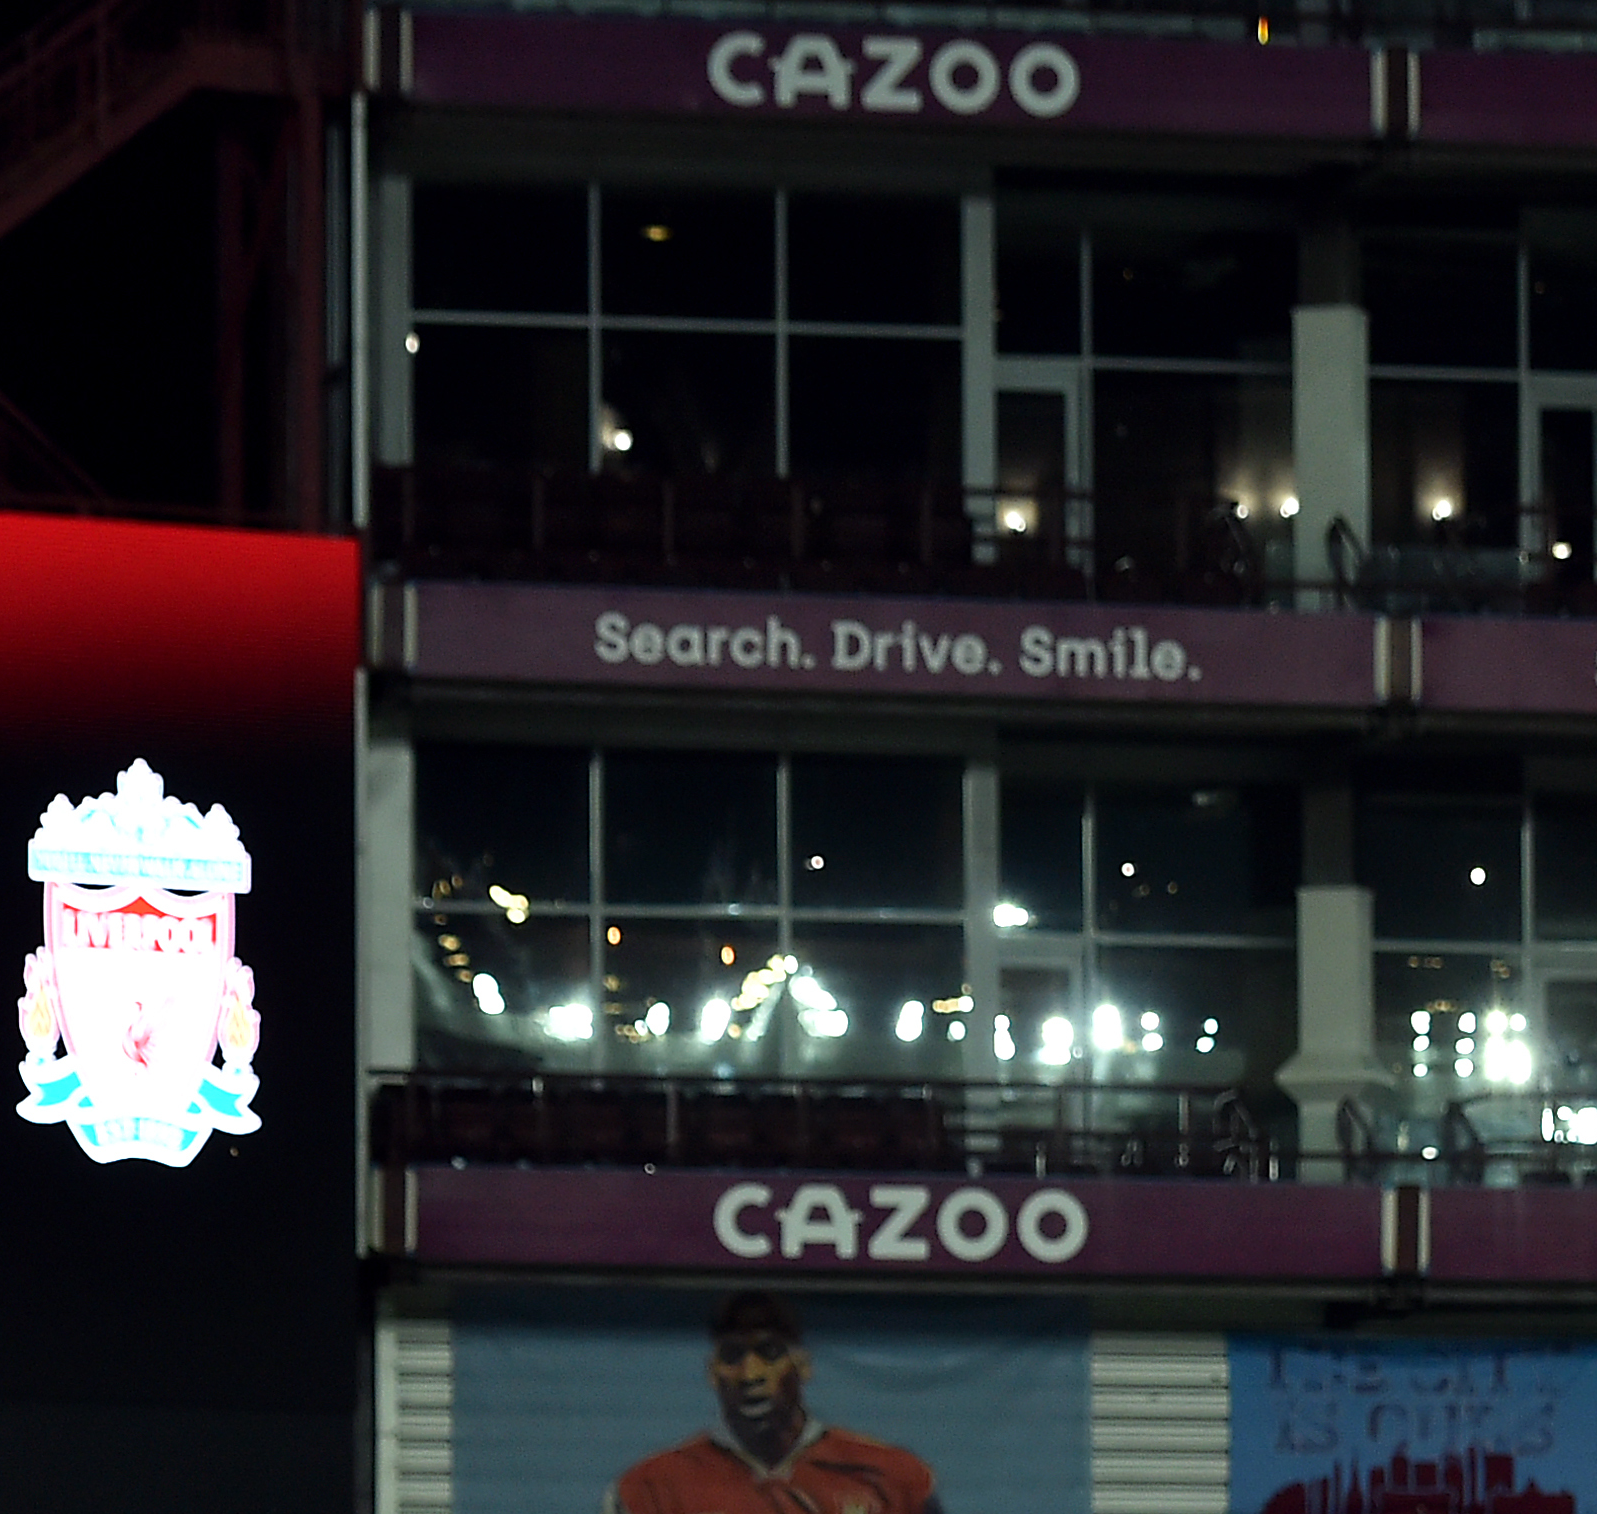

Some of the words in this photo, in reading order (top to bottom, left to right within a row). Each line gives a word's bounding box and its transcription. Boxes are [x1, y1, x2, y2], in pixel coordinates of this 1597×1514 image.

[706, 32, 1081, 118] CAZOO
[593, 611, 818, 674] Search.
[829, 620, 1004, 678] Drive.
[1017, 626, 1203, 682] Smile.
[712, 1182, 1089, 1264] CAZOO
